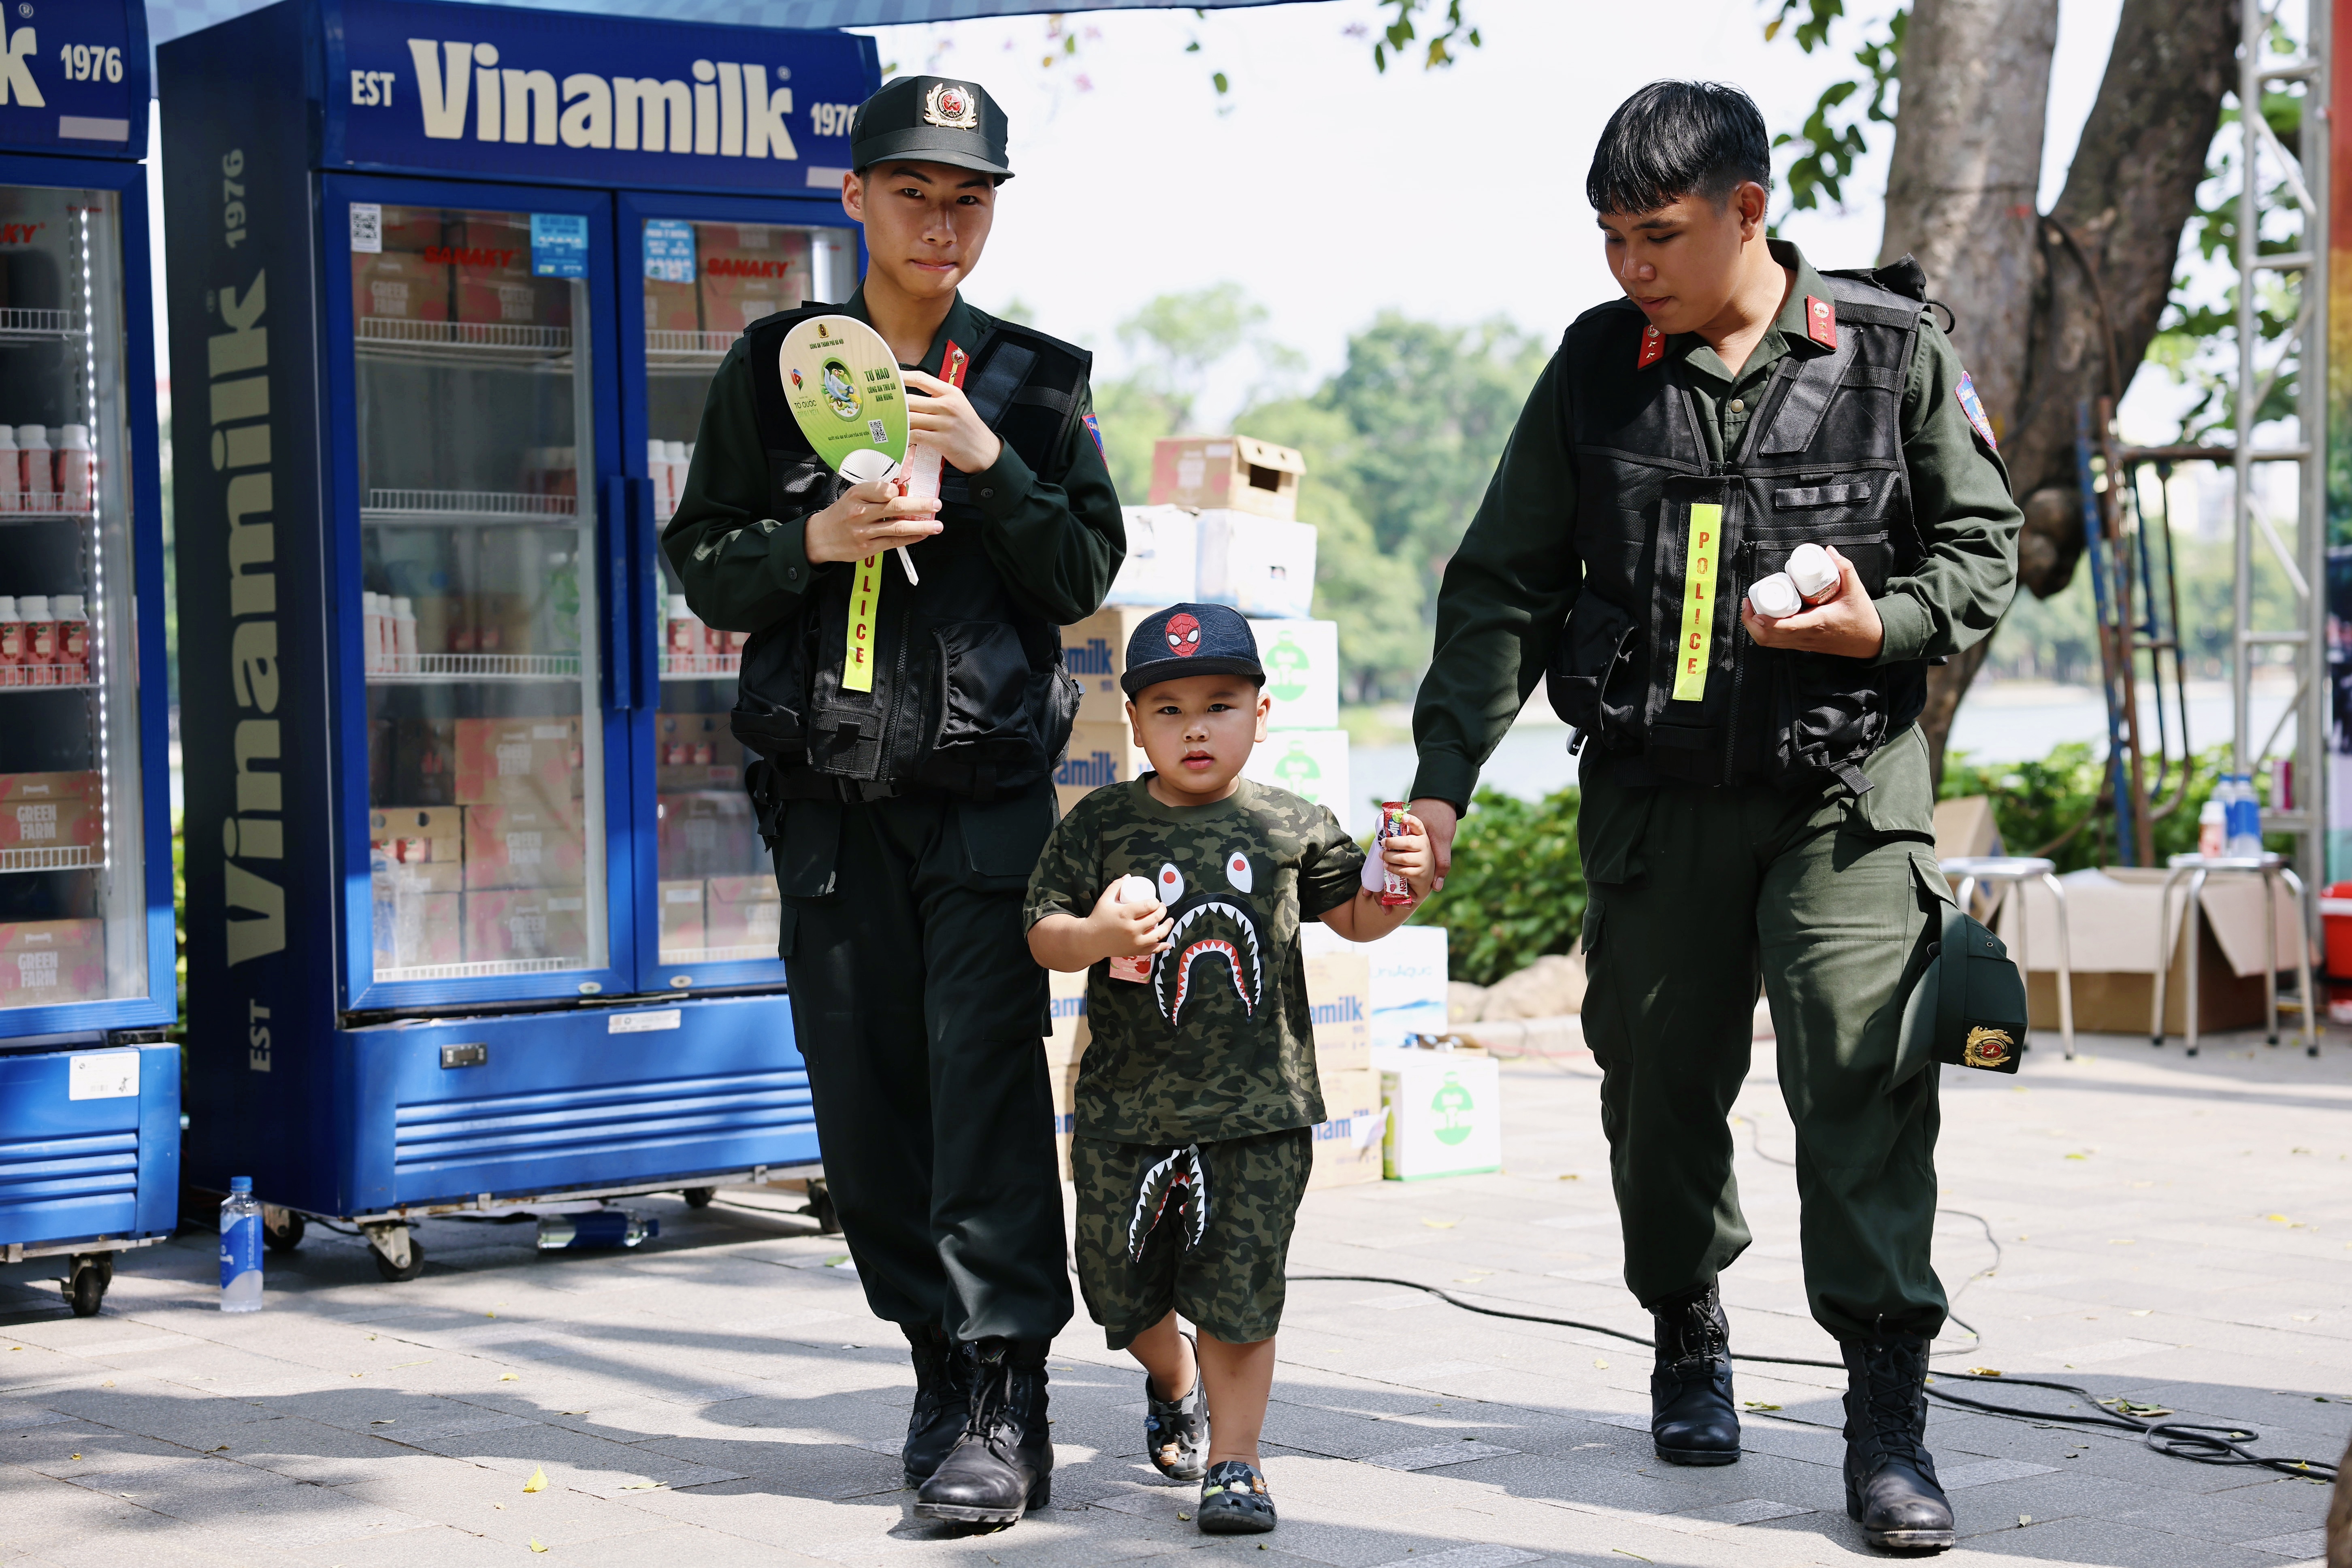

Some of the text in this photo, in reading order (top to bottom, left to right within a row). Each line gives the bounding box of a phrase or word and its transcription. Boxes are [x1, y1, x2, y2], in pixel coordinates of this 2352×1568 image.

[61, 43, 123, 83] 1976
[351, 70, 395, 107] EST
[407, 38, 798, 160] Vinamilk
[424, 245, 515, 268] SANAKY
[706, 258, 788, 278] SANAKY
[864, 366, 890, 383] TỰ HÀO
[867, 386, 878, 394] CÔNG
[209, 148, 286, 1072] EST Vinamilk 1976
[856, 554, 875, 663] OLICE
[1687, 532, 1709, 674] POLICE
